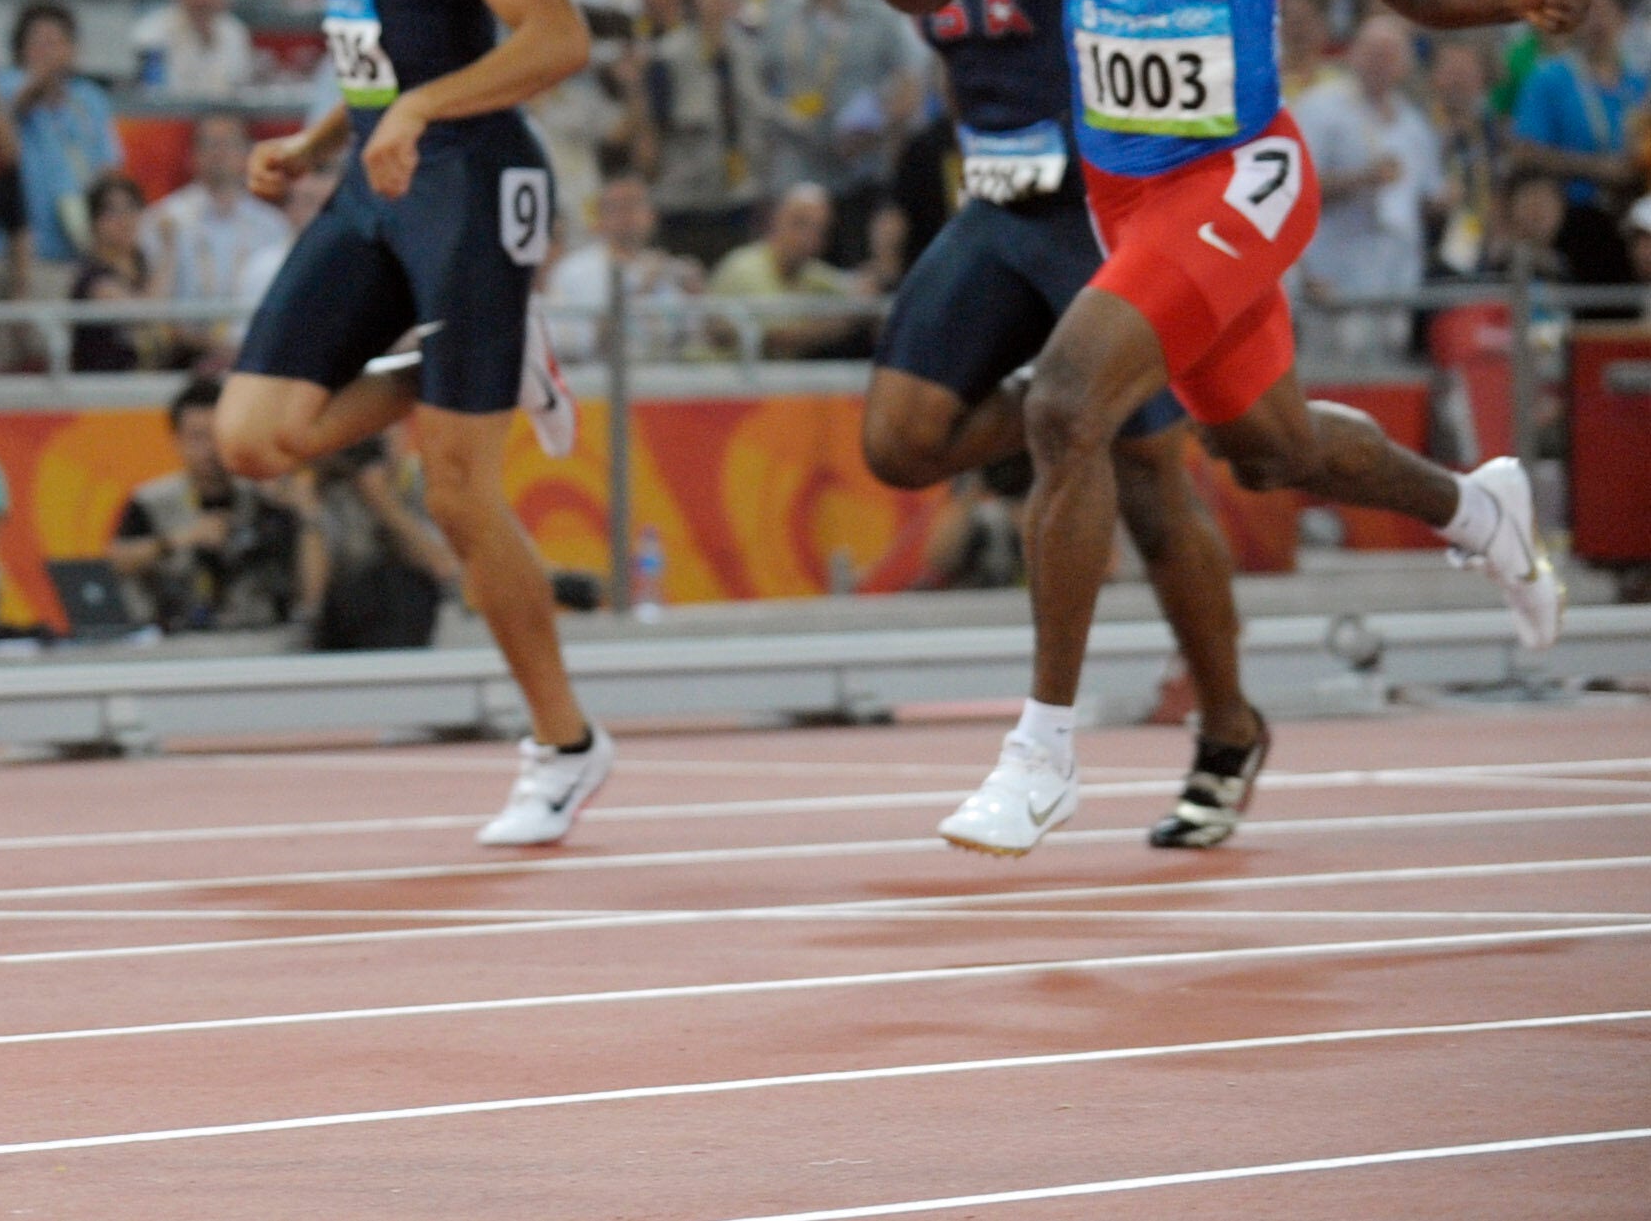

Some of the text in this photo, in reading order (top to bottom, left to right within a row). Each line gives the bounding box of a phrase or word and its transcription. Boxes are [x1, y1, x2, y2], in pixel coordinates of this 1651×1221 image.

[1091, 44, 1207, 110] 1003
[1247, 148, 1290, 206] 7
[513, 182, 538, 250] 9
